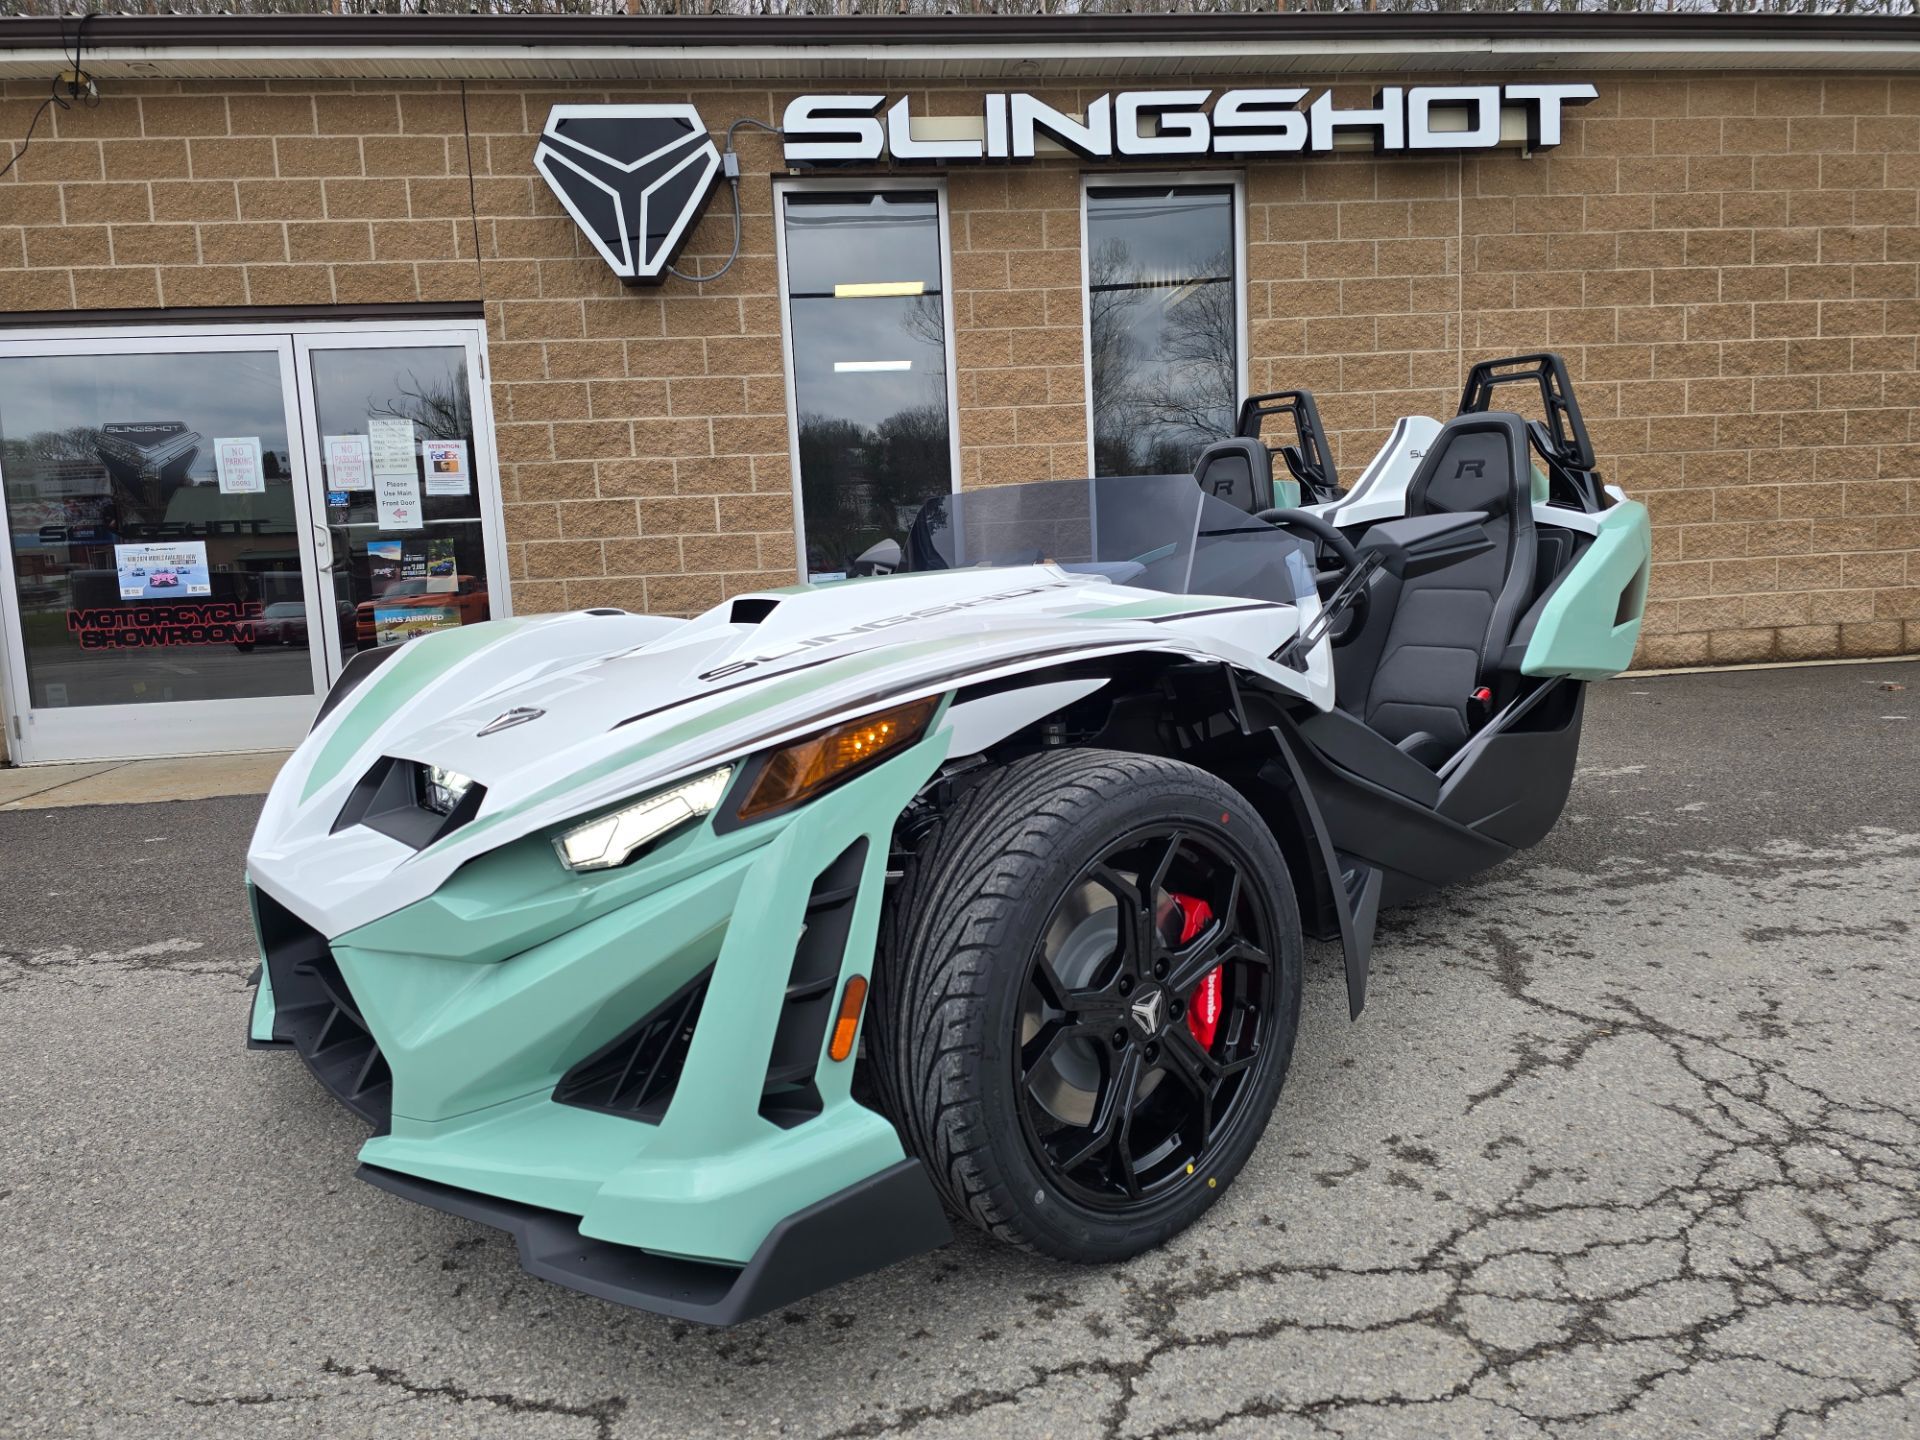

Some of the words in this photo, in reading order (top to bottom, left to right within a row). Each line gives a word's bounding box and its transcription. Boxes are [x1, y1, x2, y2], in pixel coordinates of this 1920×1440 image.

[783, 84, 1599, 160] SLINGSHOT
[106, 425, 180, 433] SLINGSHOT
[232, 448, 244, 456] NO
[340, 444, 352, 453] NO
[334, 454, 362, 464] PARKING
[430, 450, 458, 460] FedEx
[68, 602, 263, 630] MOTORCYCLE
[404, 614, 444, 622] ARRIVED
[81, 623, 254, 649] SHOWROOM
[1207, 973, 1217, 1024] brembo
